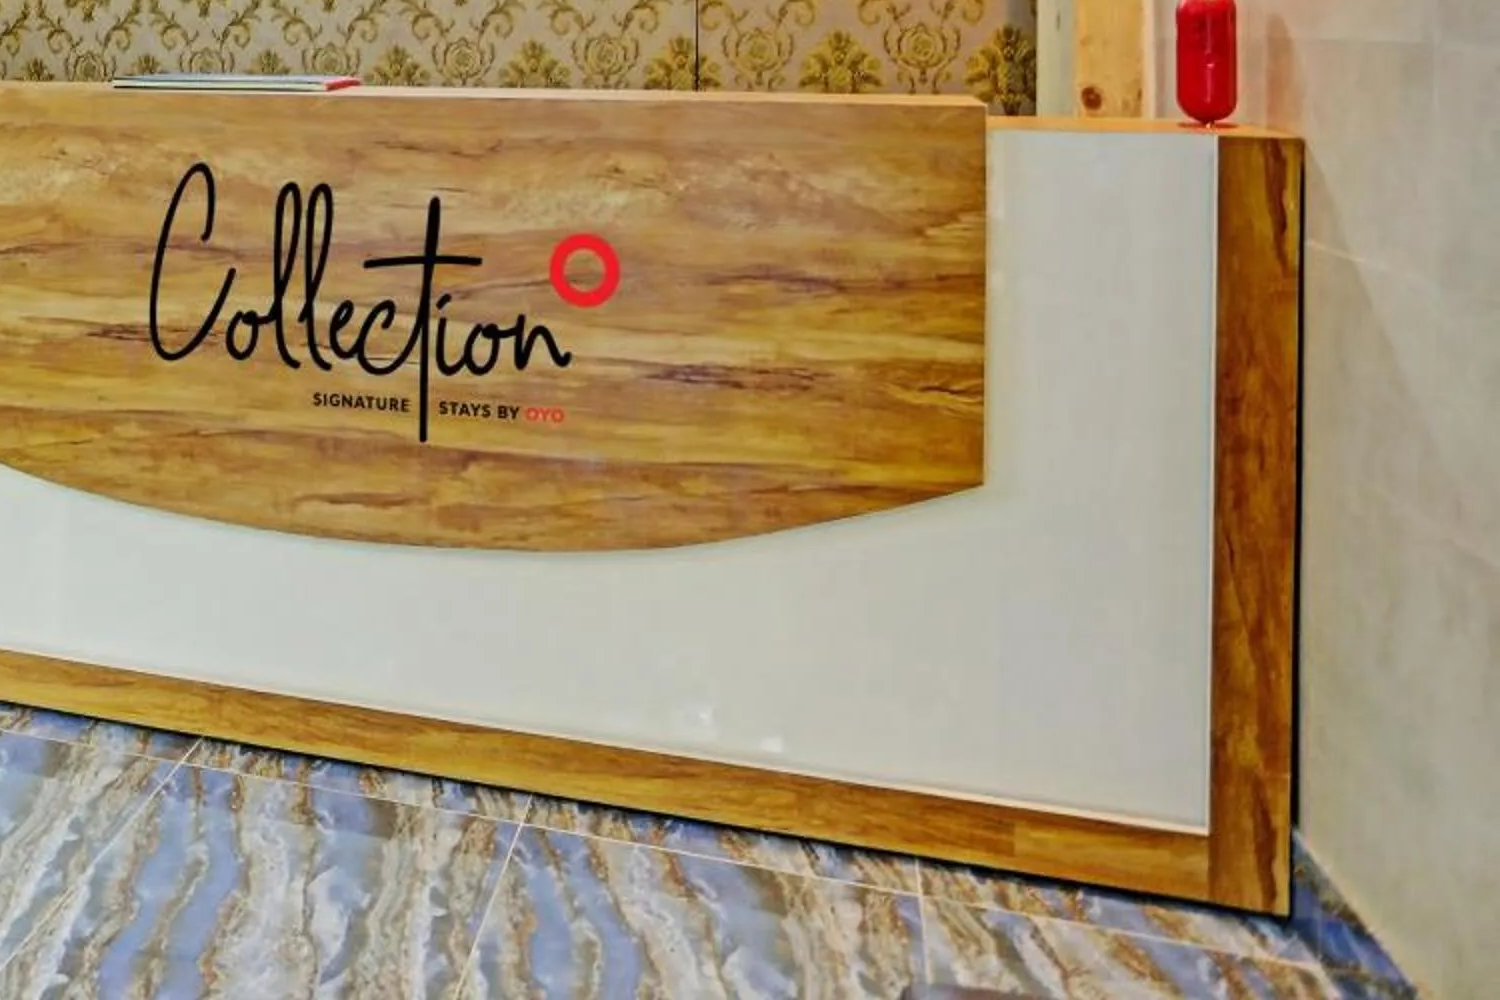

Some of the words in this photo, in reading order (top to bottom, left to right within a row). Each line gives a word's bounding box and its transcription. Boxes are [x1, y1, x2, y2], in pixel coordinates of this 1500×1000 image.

[149, 162, 572, 443] Collection
[312, 392, 411, 413] SIGNATURE
[438, 400, 492, 419] STAYS
[496, 404, 521, 420] BY
[524, 406, 566, 424] OYO
